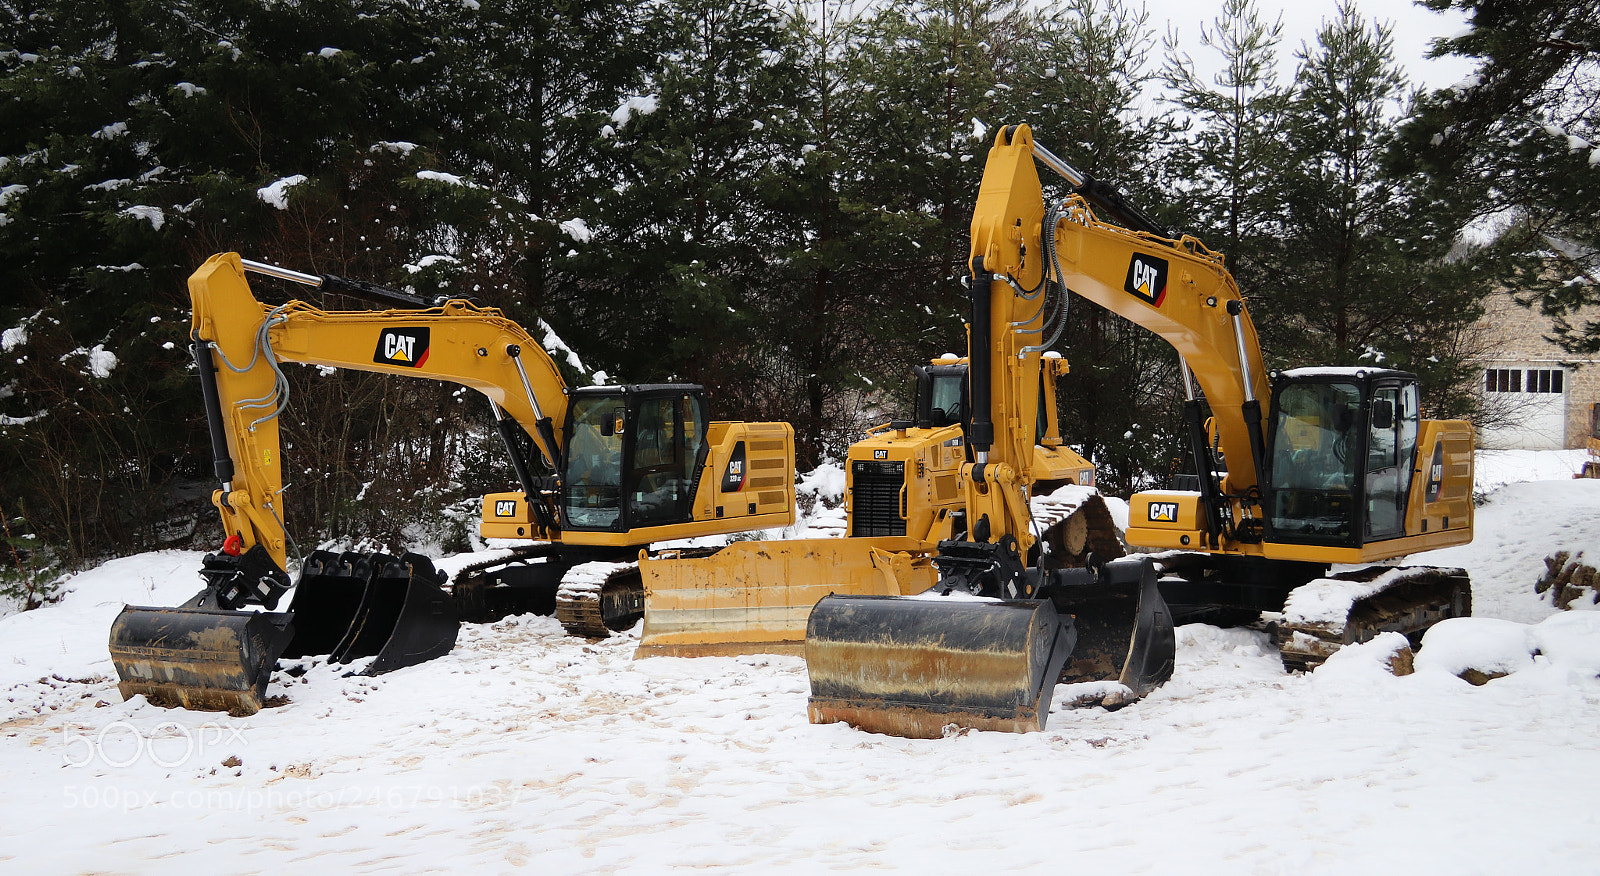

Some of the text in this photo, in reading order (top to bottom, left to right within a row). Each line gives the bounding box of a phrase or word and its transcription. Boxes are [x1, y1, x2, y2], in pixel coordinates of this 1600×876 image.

[1133, 259, 1158, 298] CAT
[384, 333, 416, 362] CAT
[875, 450, 887, 459] CAT
[730, 460, 742, 474] CAT
[1432, 464, 1442, 481] CAT
[1079, 471, 1089, 486] CAT
[496, 501, 515, 516] CAT
[1150, 503, 1176, 520] CAT
